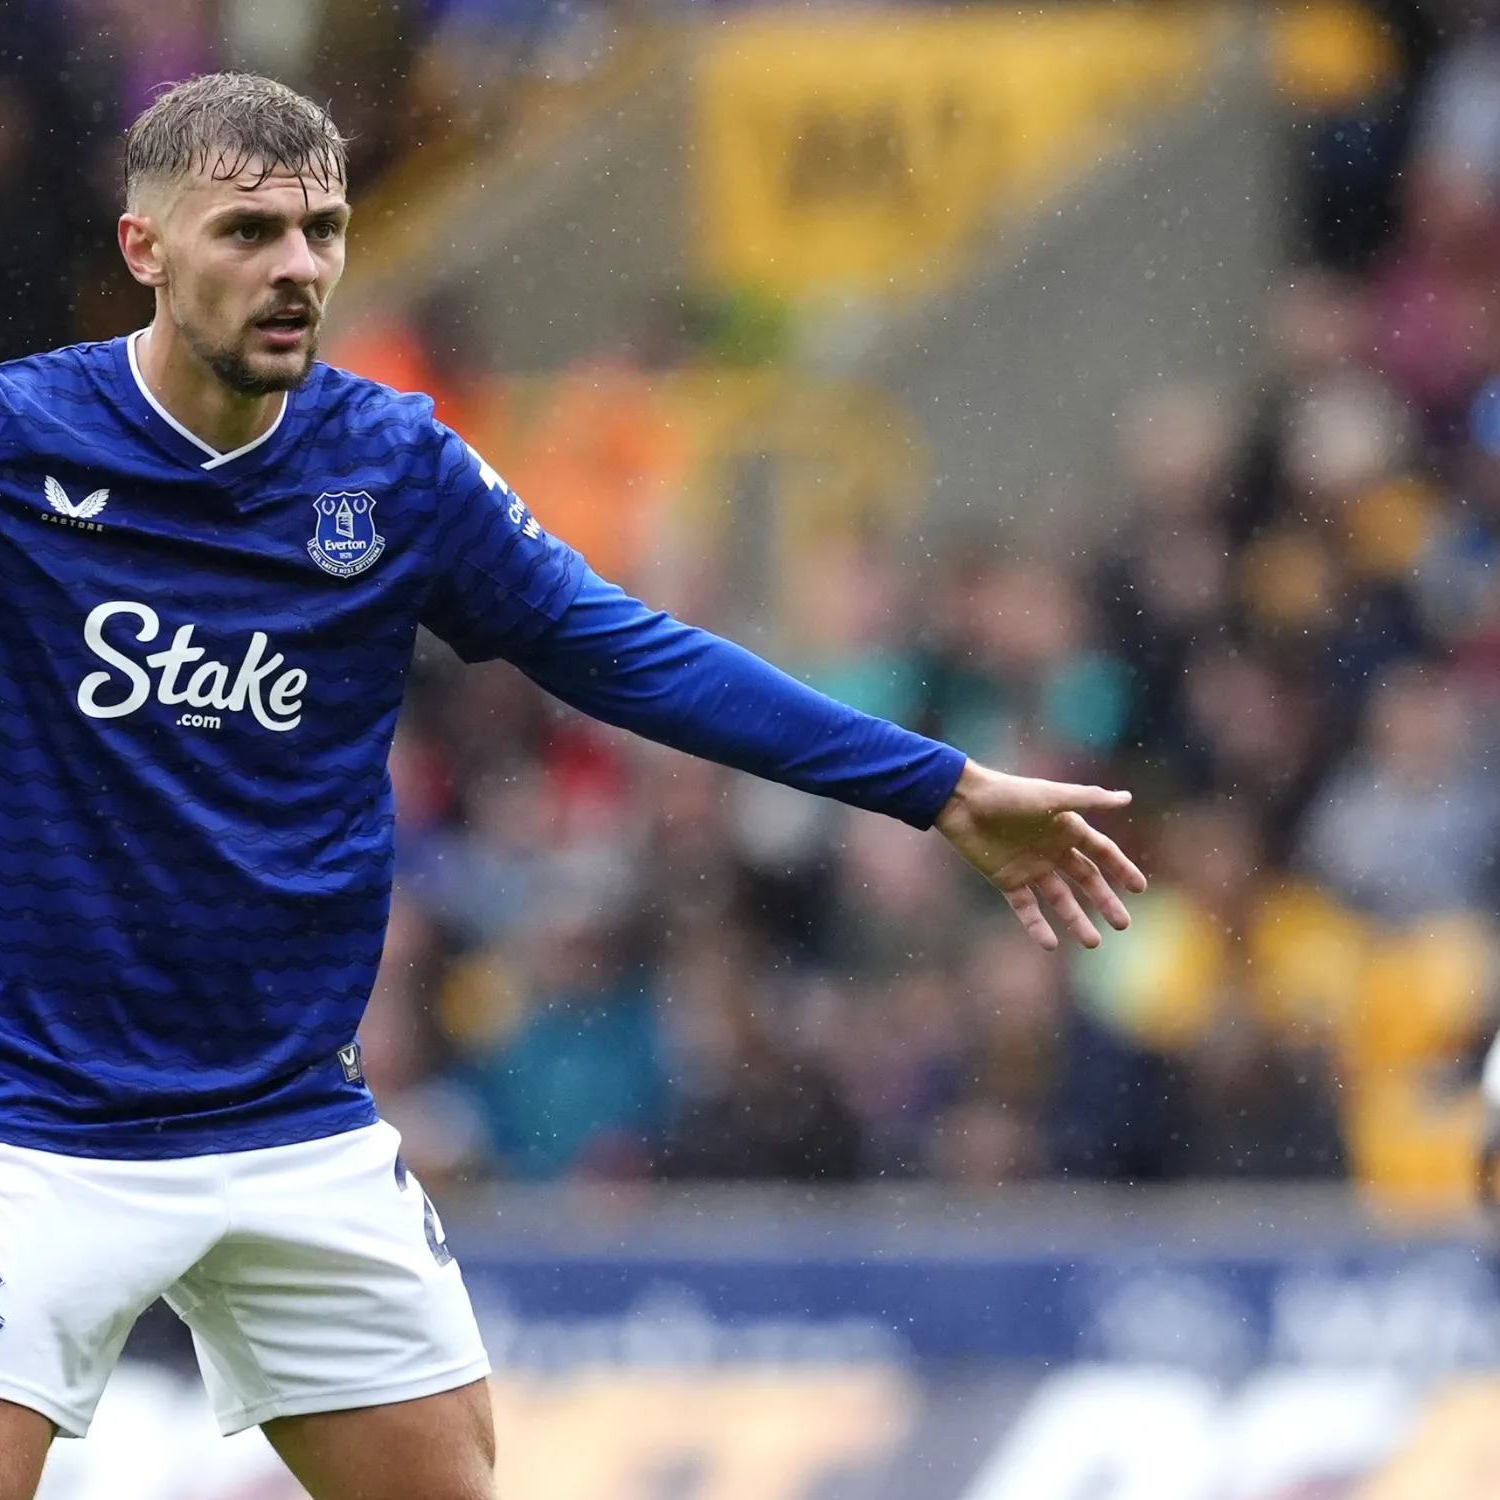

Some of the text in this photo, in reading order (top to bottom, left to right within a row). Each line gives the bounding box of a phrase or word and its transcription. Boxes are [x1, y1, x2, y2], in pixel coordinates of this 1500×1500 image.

[40, 513, 104, 532] CASTORE
[324, 540, 366, 551] Everton
[77, 600, 308, 732] Stake
[175, 712, 222, 730] .com
